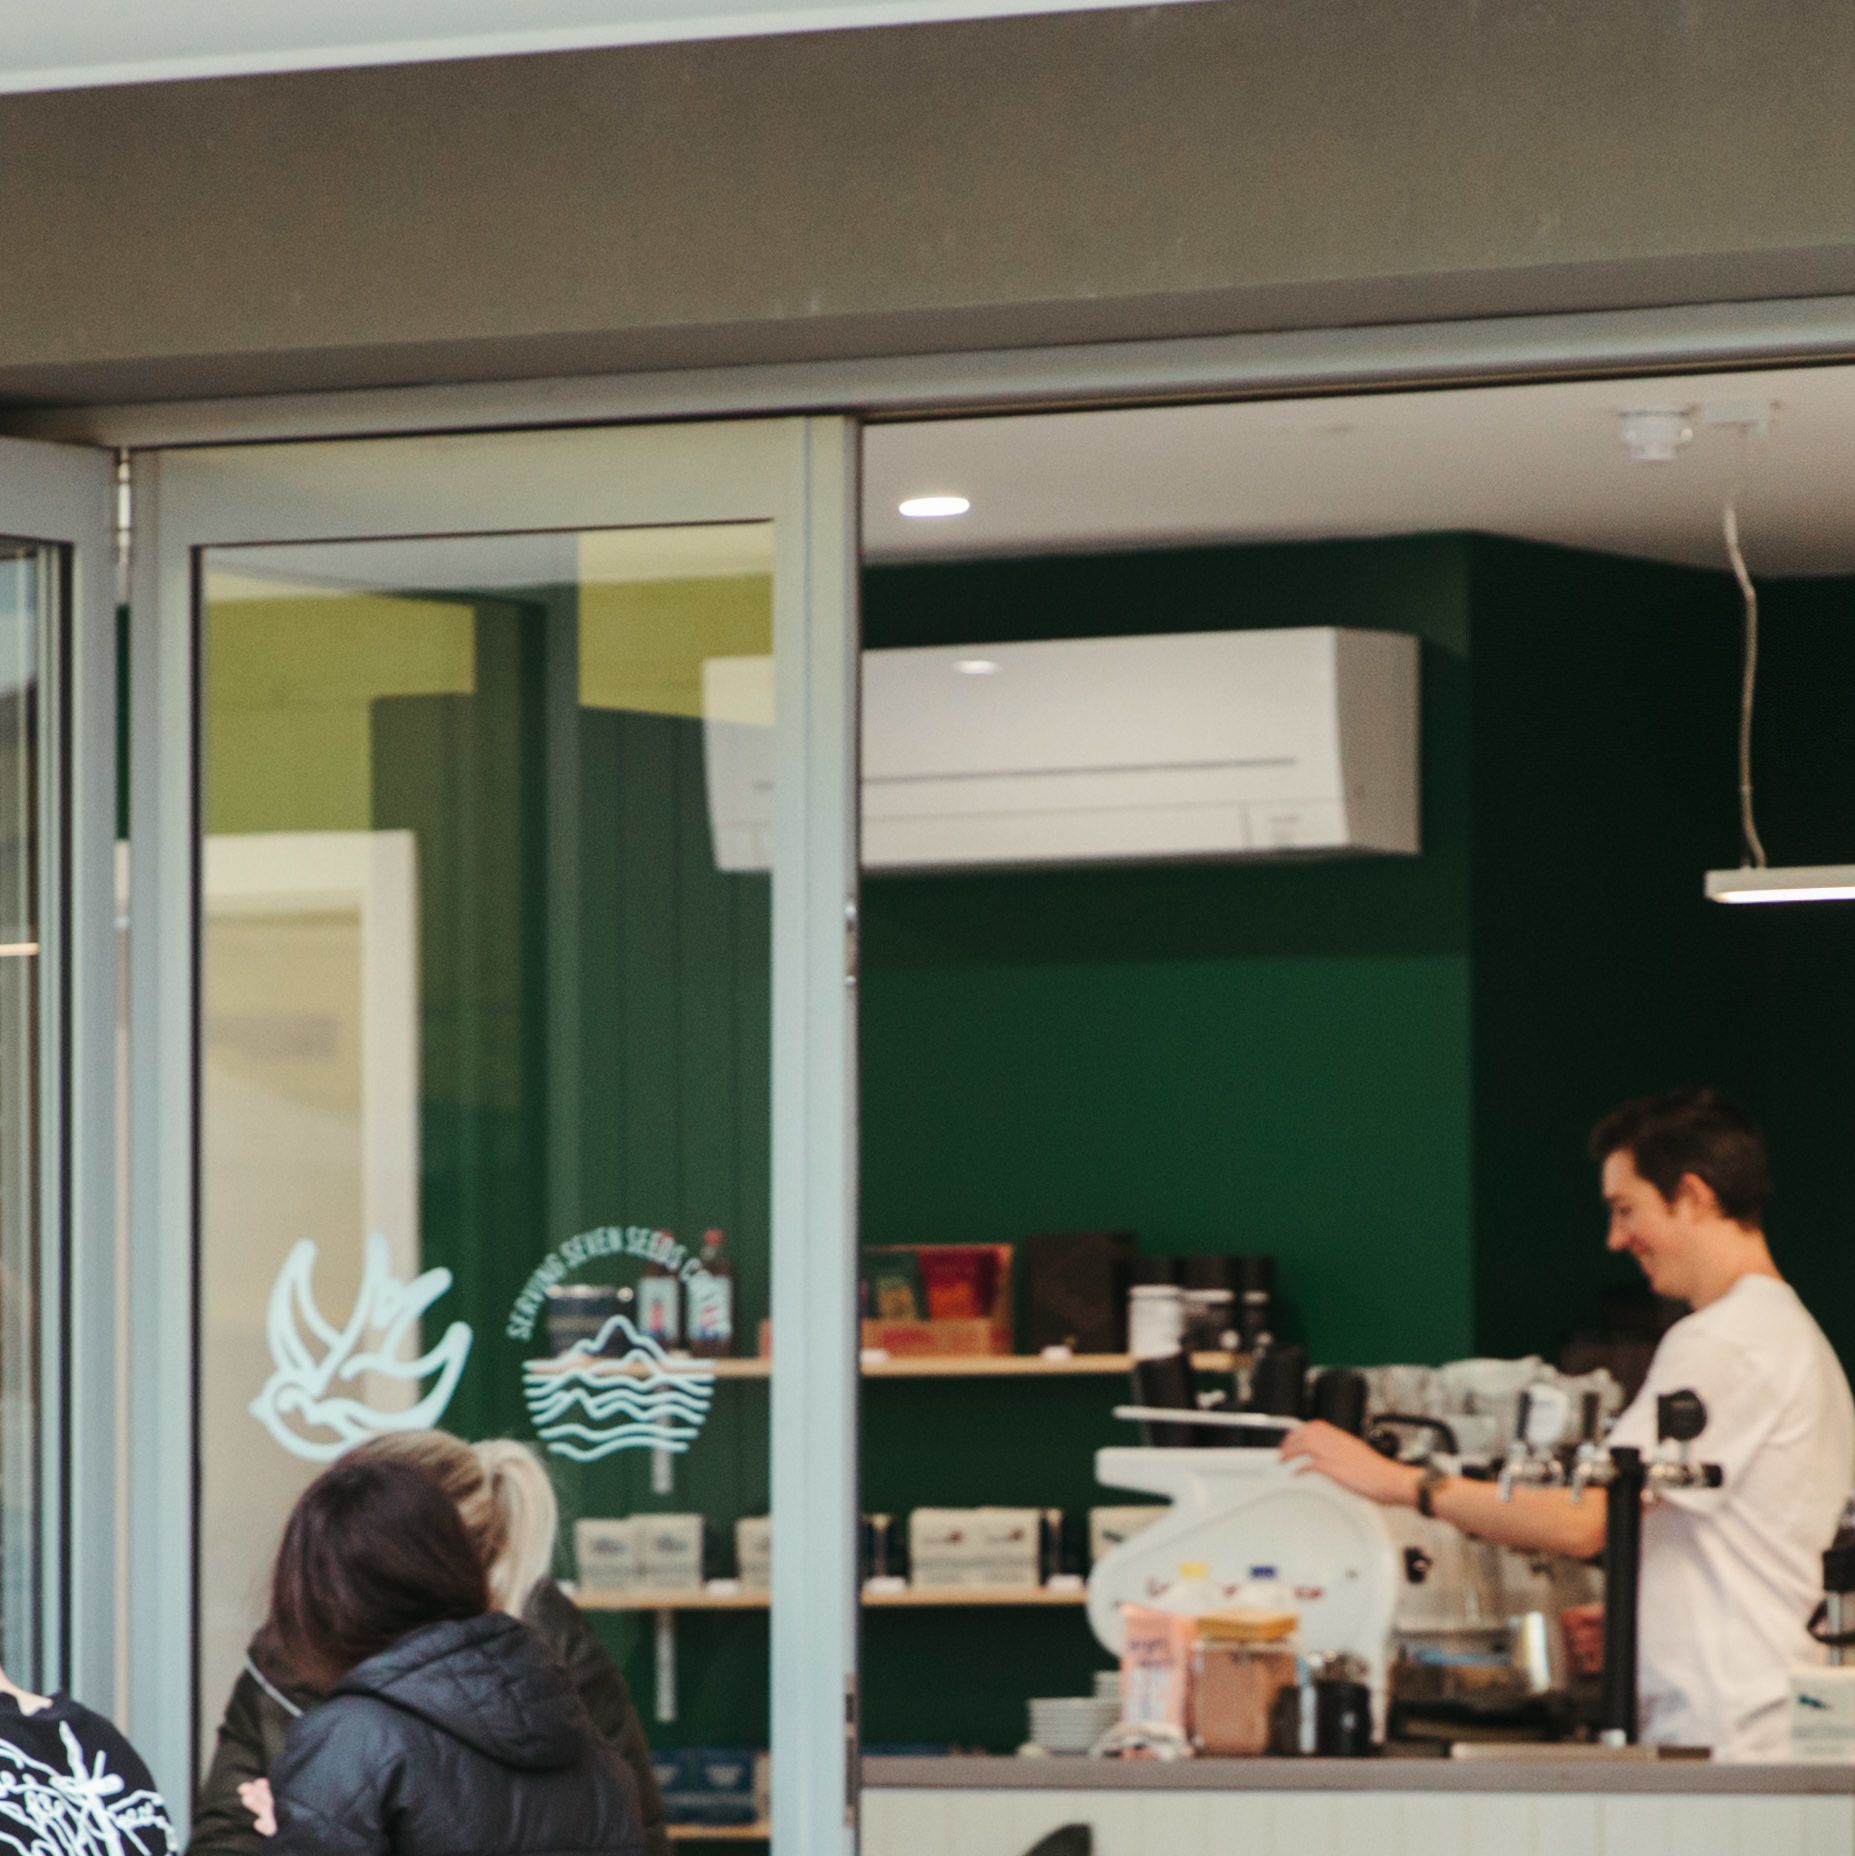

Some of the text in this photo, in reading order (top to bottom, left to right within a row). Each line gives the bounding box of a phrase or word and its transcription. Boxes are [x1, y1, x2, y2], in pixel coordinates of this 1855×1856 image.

[505, 1226, 688, 1341] SERVING SEVEN SEEDS
